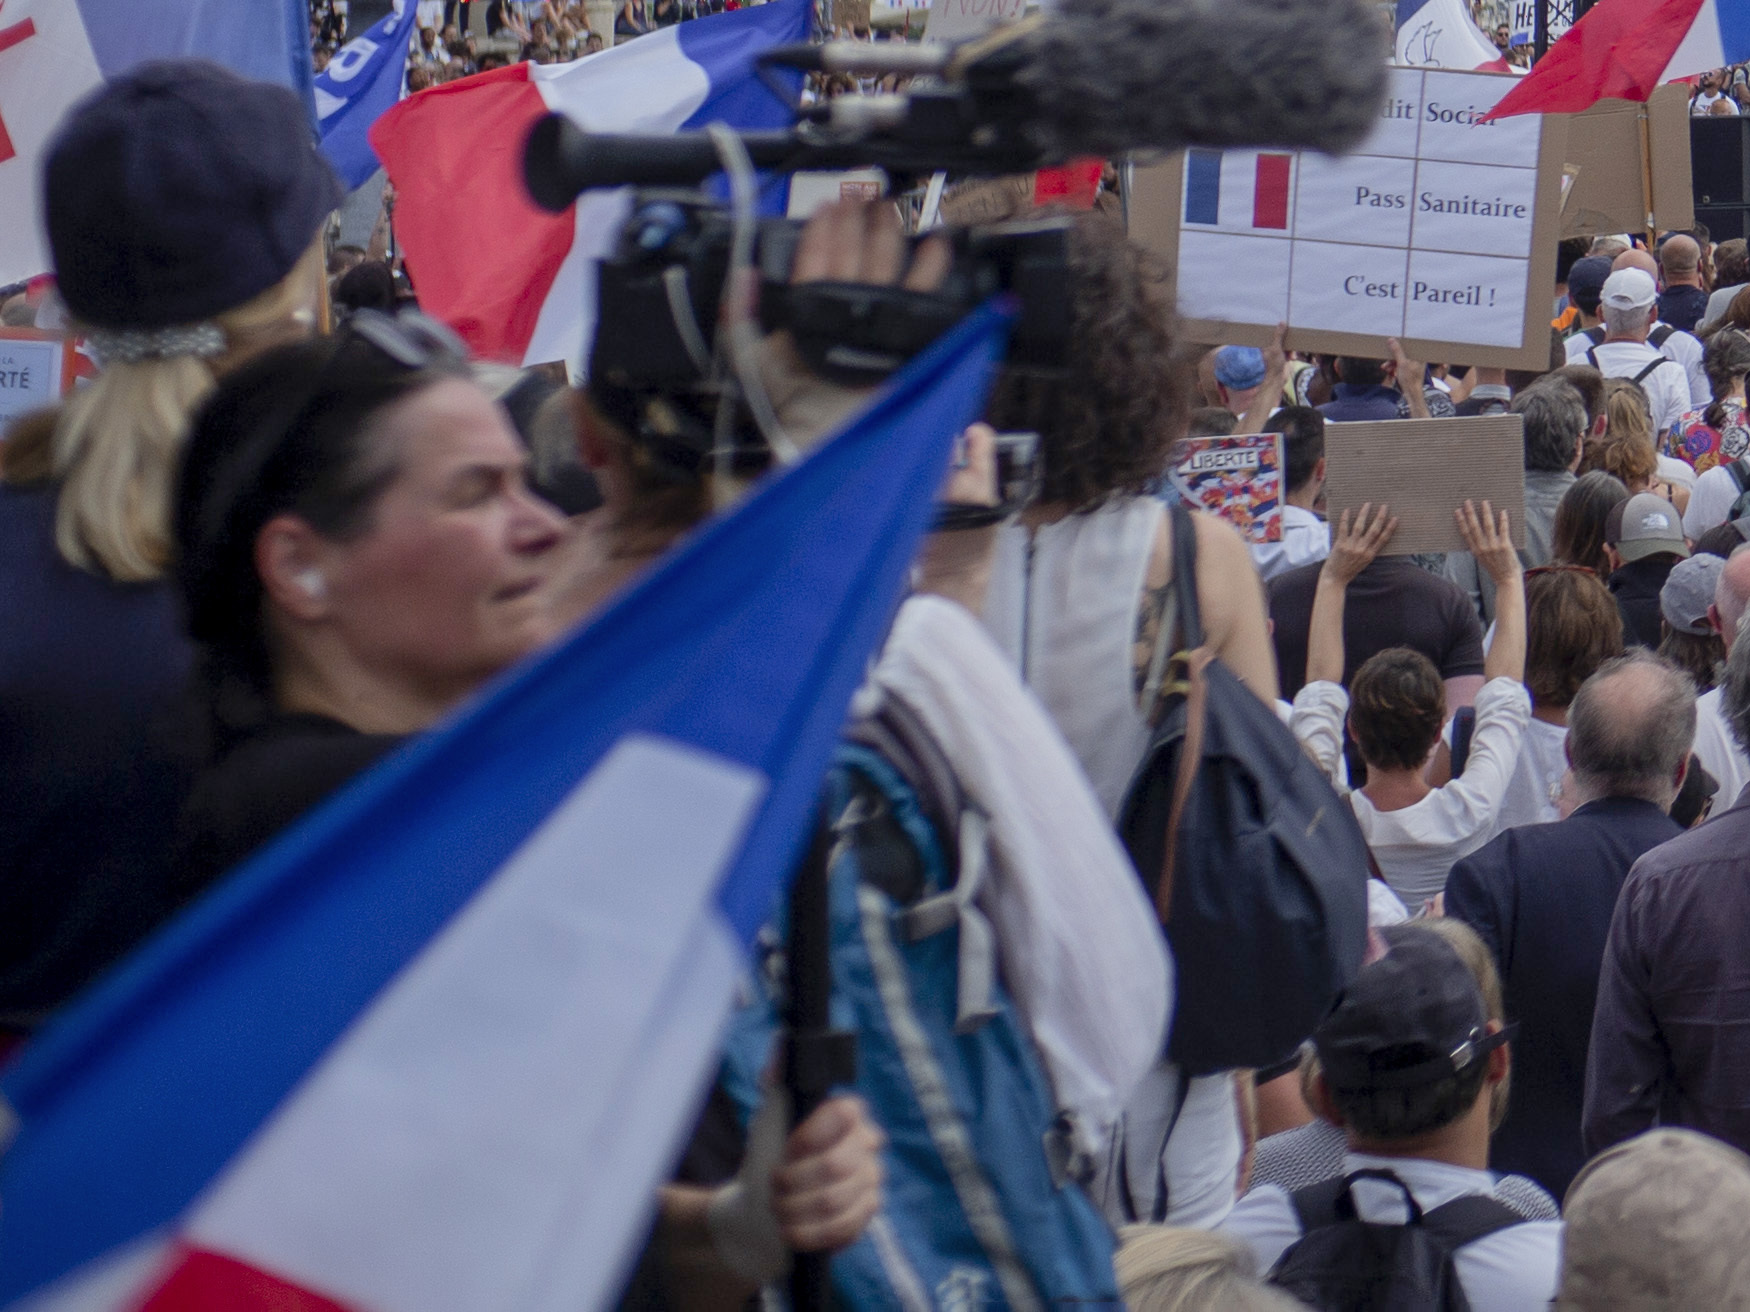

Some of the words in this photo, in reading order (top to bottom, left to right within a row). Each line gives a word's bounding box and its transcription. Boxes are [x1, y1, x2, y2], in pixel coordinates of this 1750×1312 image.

[1355, 185, 1406, 209] Pass
[1420, 191, 1527, 219] Sanitaire
[1344, 275, 1400, 299] C'est
[1412, 281, 1481, 307] Pareil
[1488, 288, 1497, 307] !
[1190, 451, 1255, 470] LIBERTE
